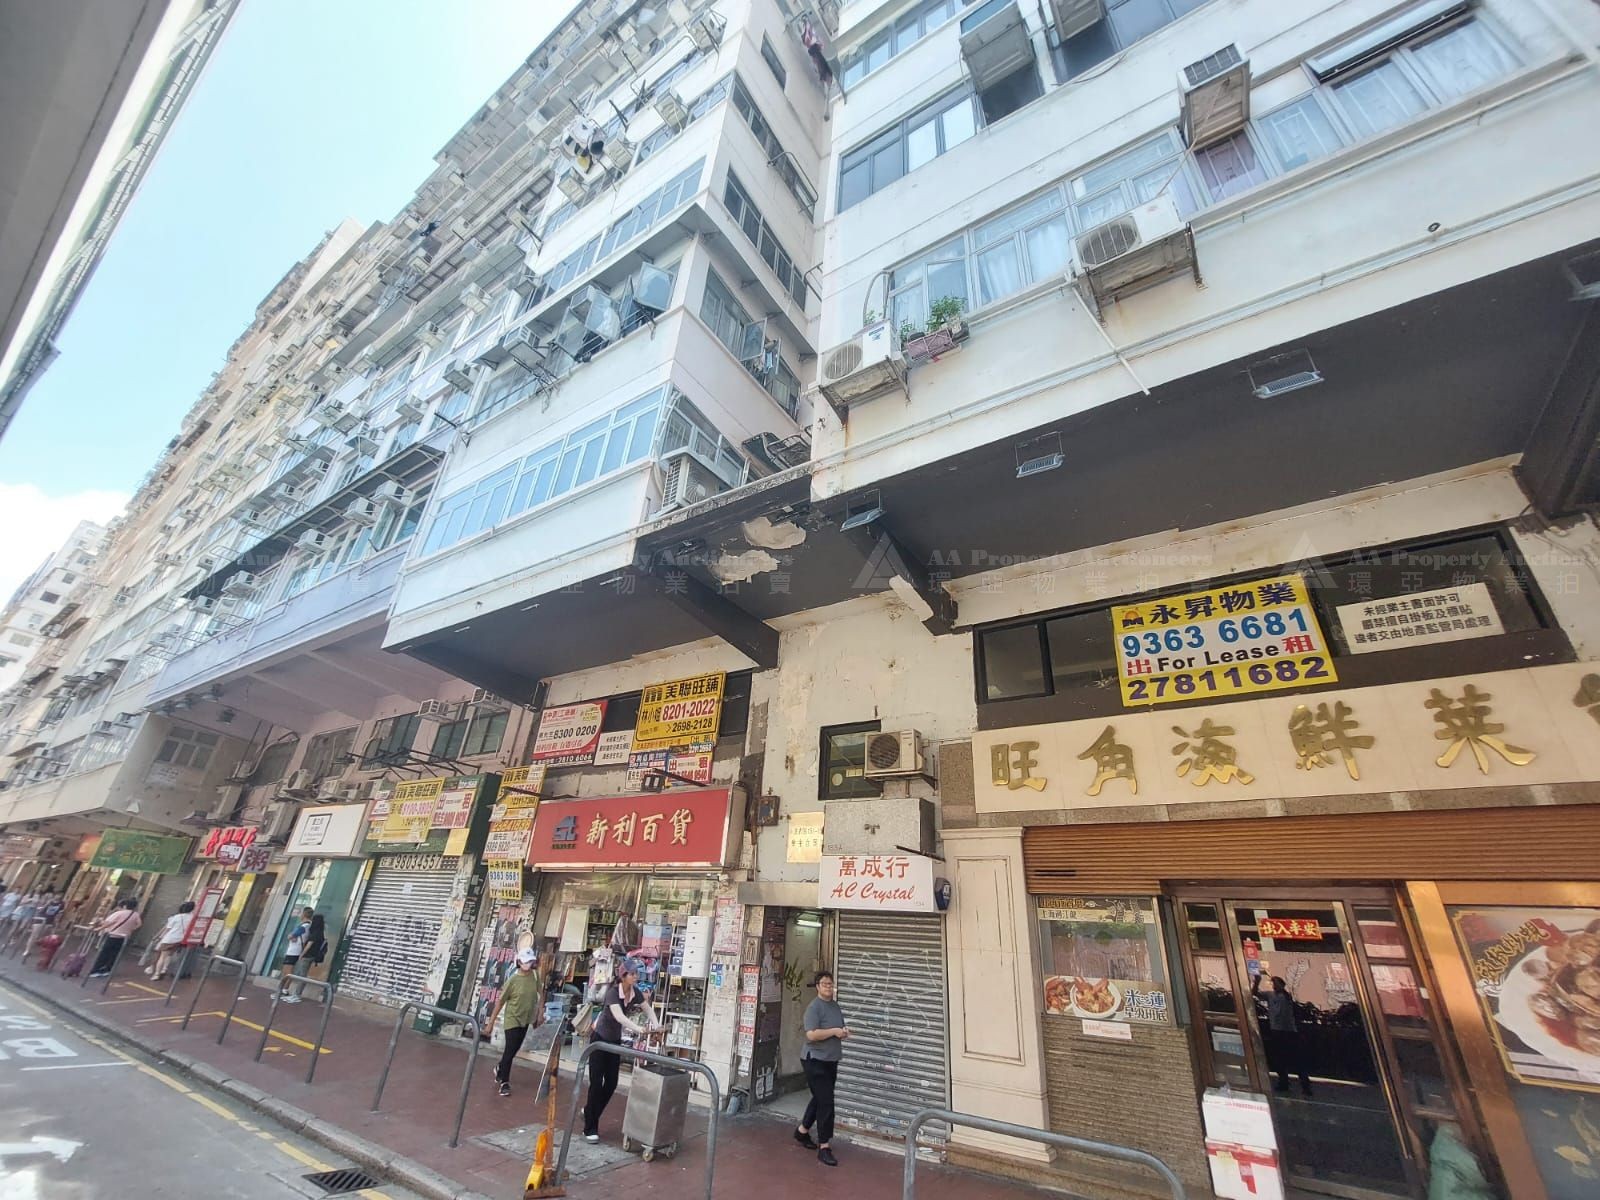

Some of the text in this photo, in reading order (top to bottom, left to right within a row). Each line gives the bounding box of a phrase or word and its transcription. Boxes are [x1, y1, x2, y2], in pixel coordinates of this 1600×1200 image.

[1149, 582, 1298, 624] 永昇物業
[1122, 608, 1309, 657] 9363 6681
[1126, 634, 1317, 676] 出 For Lease 租
[1127, 656, 1329, 700] 27811682
[662, 698, 716, 721] 8201-2022
[671, 717, 713, 733] 2698-2128
[553, 727, 573, 739] 8300
[575, 725, 597, 737] 0208
[990, 673, 1600, 797] 旺角海鮮菜
[585, 808, 693, 849] 新利百貨
[838, 856, 910, 879] 萬成行
[830, 880, 915, 903] AC Crystal
[1262, 920, 1317, 936] 出入平安
